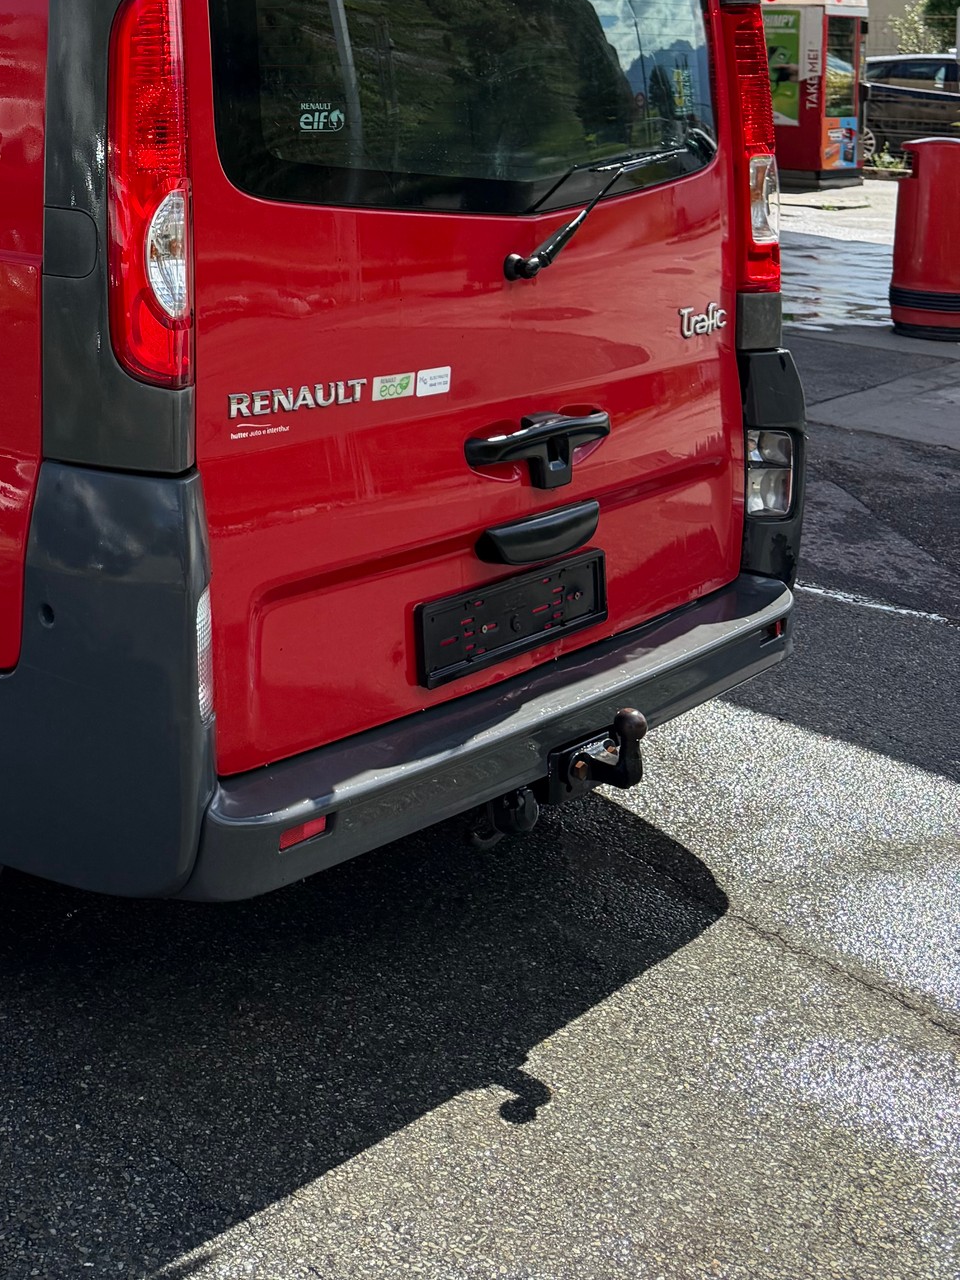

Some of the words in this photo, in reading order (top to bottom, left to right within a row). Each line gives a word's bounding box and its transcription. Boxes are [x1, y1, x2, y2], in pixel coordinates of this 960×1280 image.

[806, 49, 819, 74] ME!
[805, 76, 819, 110] TAKE
[300, 102, 332, 110] RENAULT
[299, 111, 329, 130] elf
[678, 302, 728, 338] Trafic
[228, 378, 367, 419] RENAULT
[379, 382, 404, 398] eco
